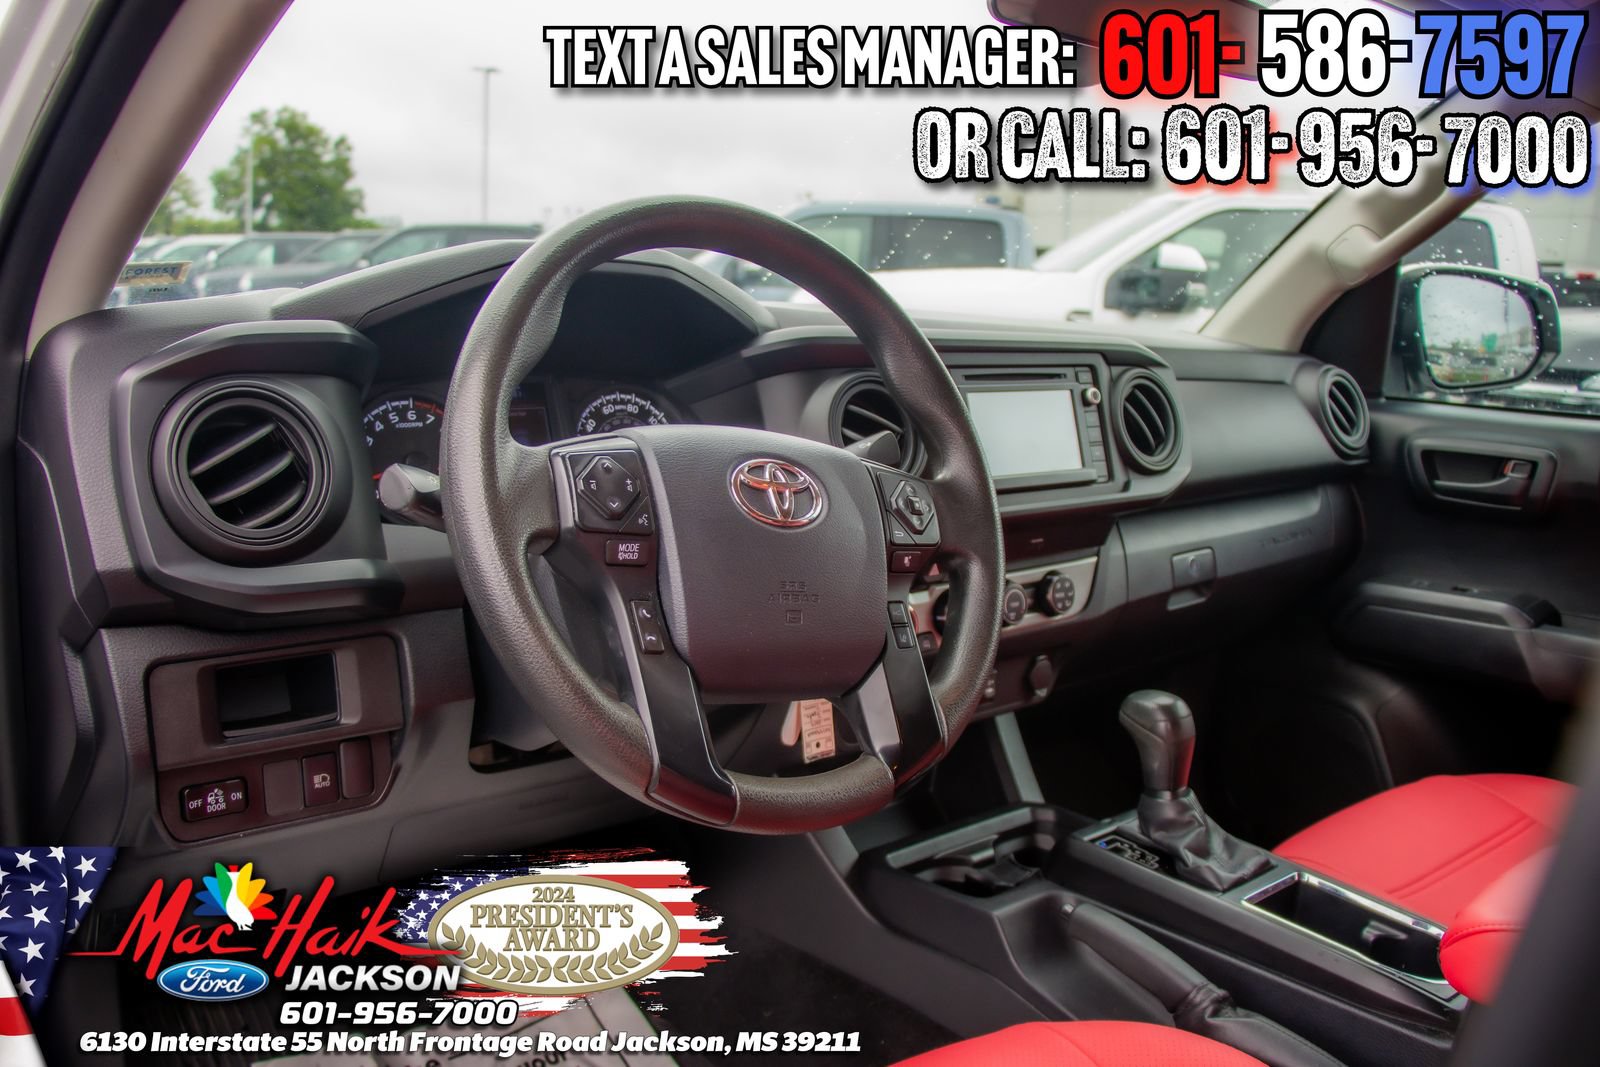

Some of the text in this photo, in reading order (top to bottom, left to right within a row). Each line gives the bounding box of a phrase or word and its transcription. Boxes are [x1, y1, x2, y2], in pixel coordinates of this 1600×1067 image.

[388, 412, 399, 423] 5
[407, 410, 417, 421] 6
[425, 413, 435, 424] 7
[618, 543, 640, 552] MODE
[622, 552, 639, 560] HOLD
[314, 781, 331, 789] AUTO
[230, 792, 243, 801] ON
[188, 799, 203, 809] OFF
[207, 802, 227, 813] DOOR
